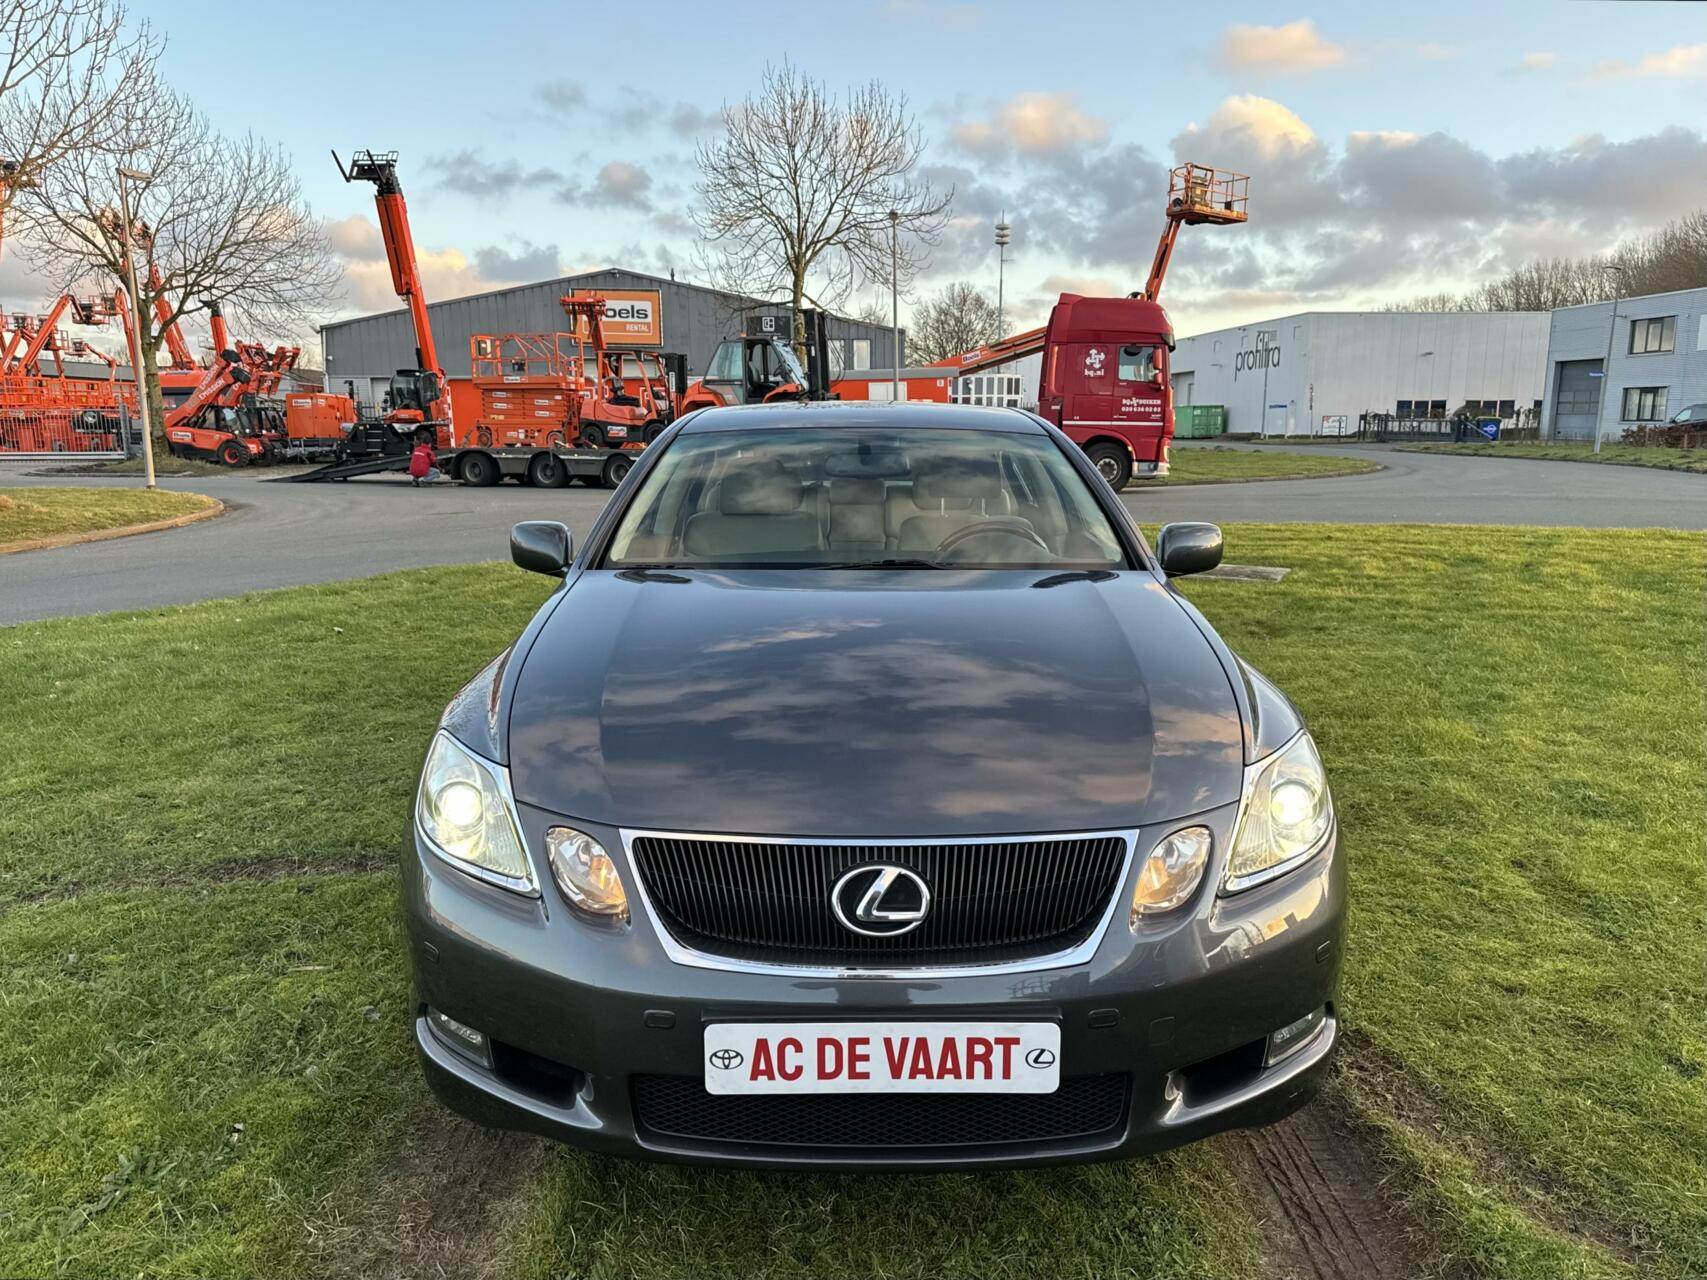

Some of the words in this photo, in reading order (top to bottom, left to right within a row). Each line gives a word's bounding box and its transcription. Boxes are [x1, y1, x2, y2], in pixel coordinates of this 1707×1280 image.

[603, 305, 648, 319] oels
[625, 323, 649, 332] RENTAL
[1234, 331, 1281, 382] profiltra
[750, 1037, 804, 1081] AC
[817, 1037, 870, 1080] DE
[883, 1036, 1021, 1080] VAART
